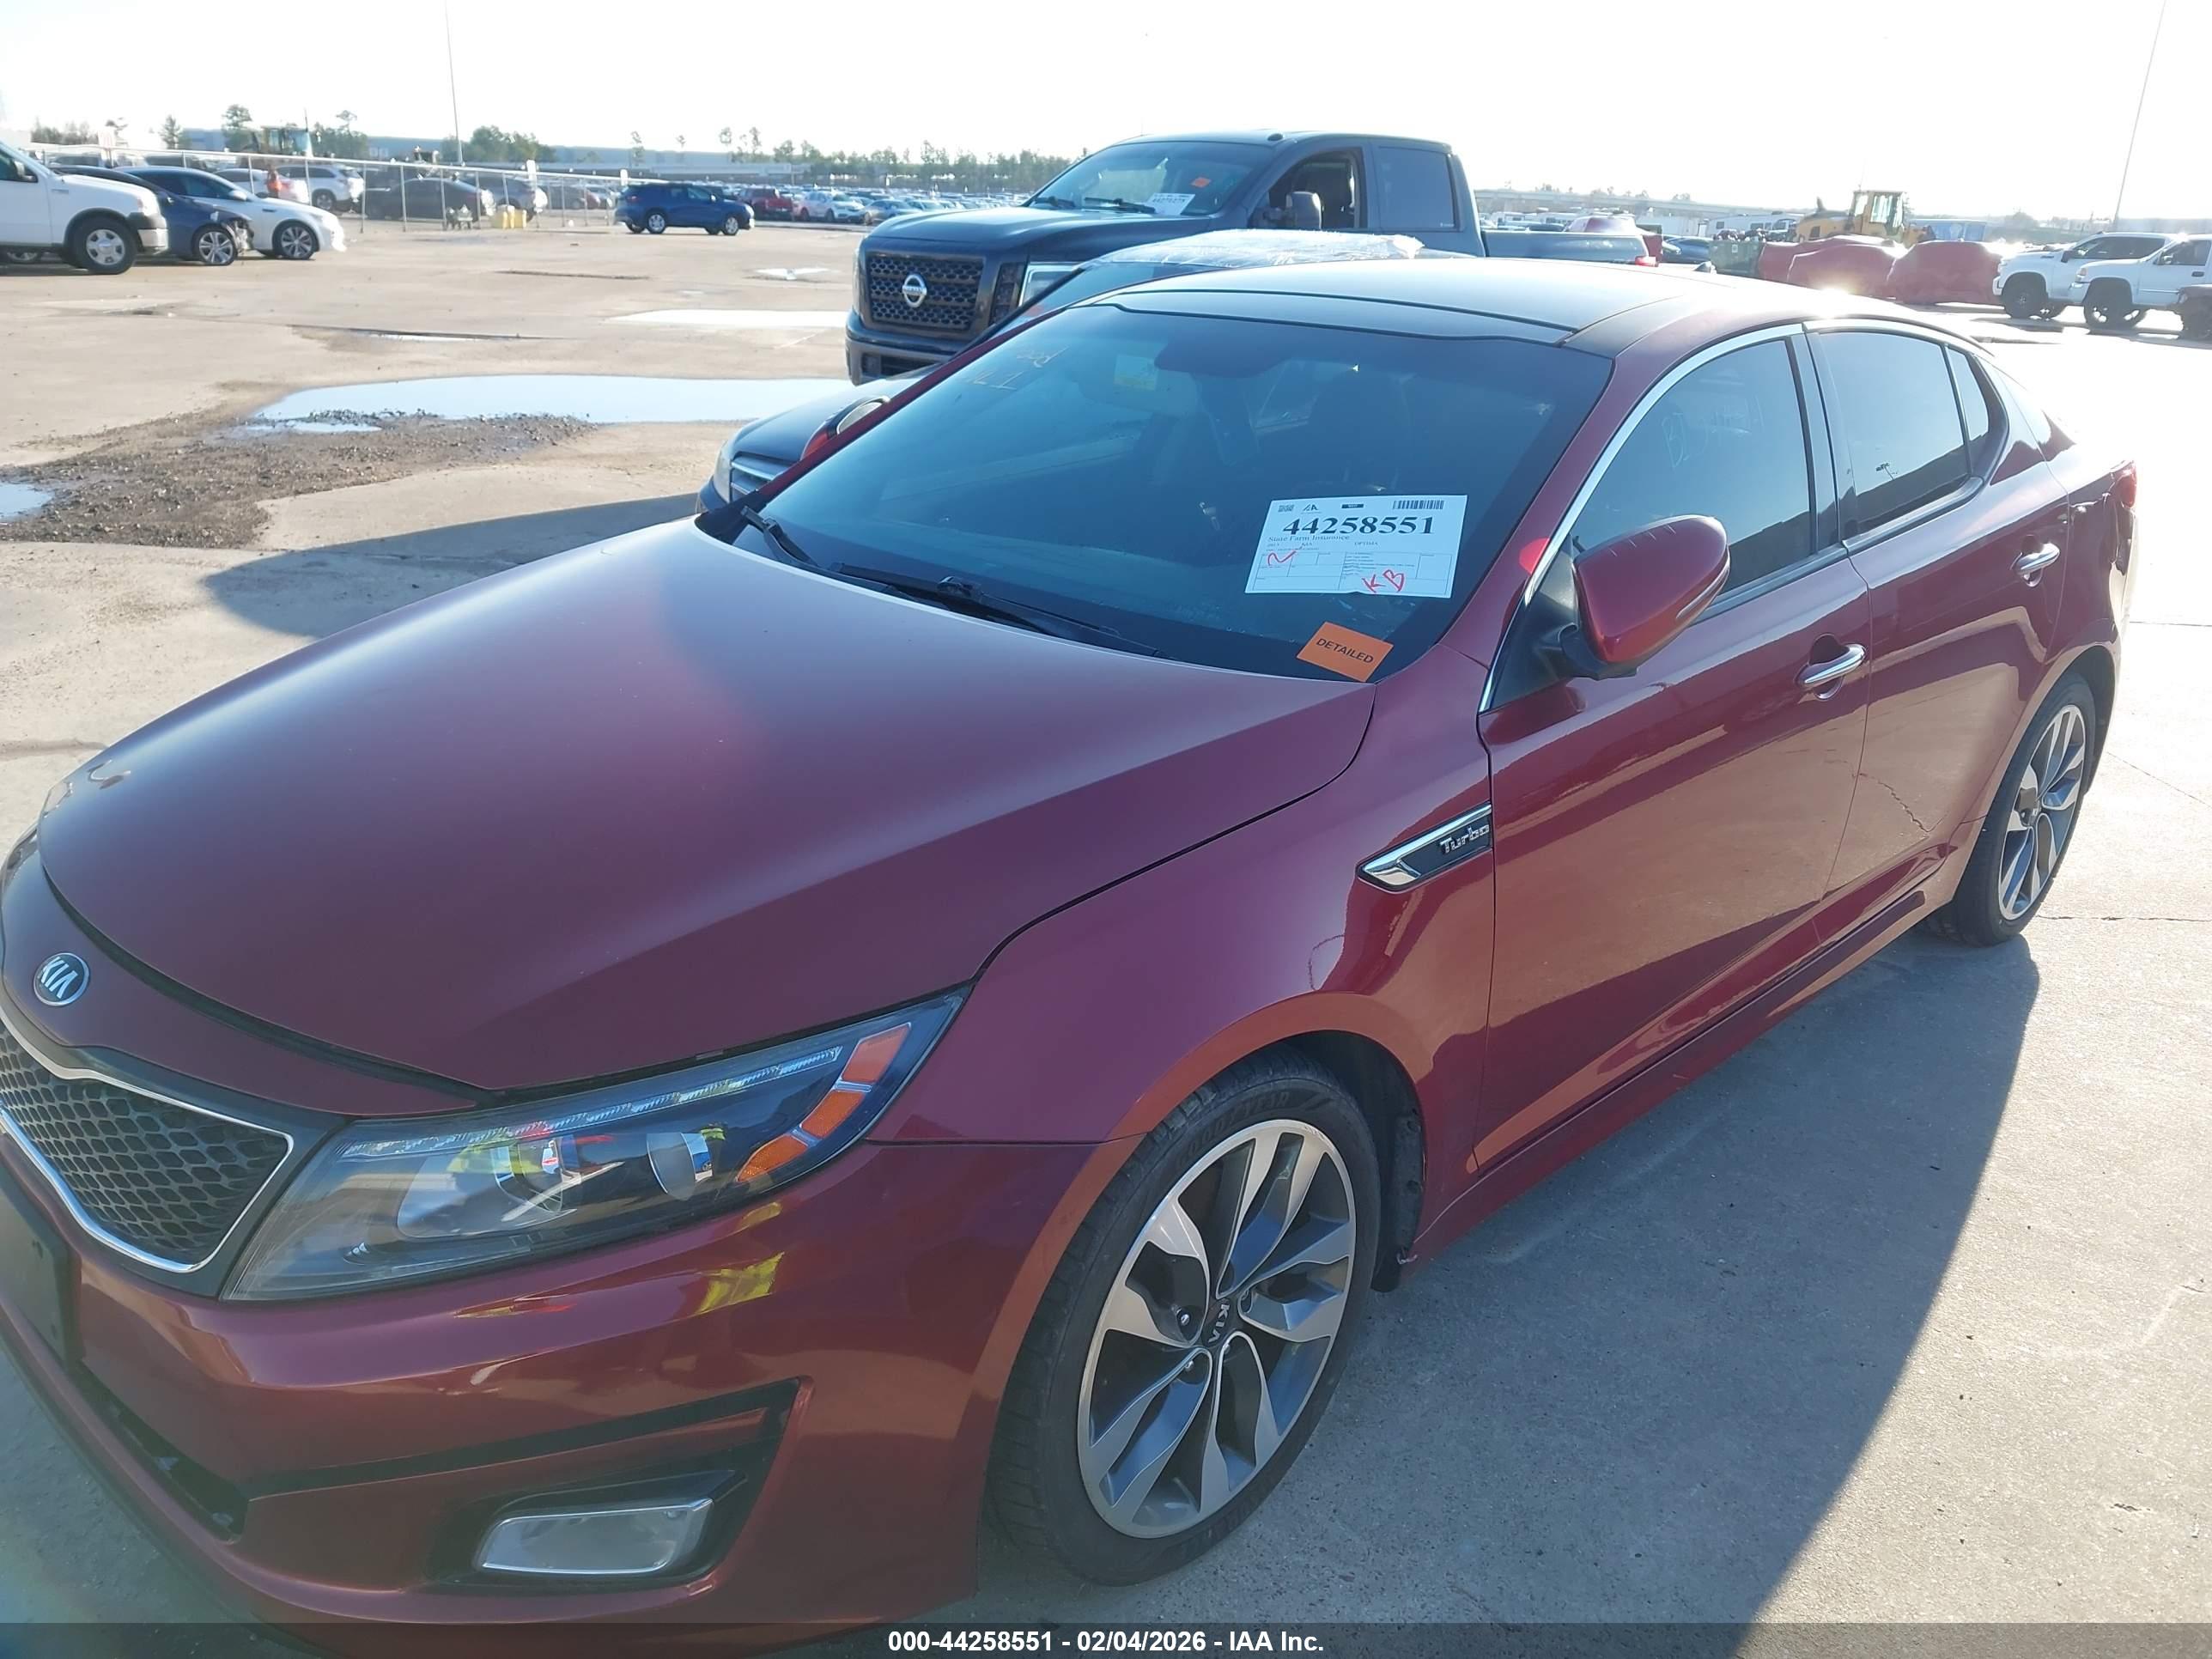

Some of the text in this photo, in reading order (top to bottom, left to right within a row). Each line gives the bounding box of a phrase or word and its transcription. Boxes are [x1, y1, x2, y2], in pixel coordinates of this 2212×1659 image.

[1283, 516, 1435, 535] 44258551
[1316, 638, 1375, 664] DETAILED
[1440, 824, 1490, 854] Turbo
[39, 956, 79, 999] KIA
[1207, 1304, 1231, 1344] KIA
